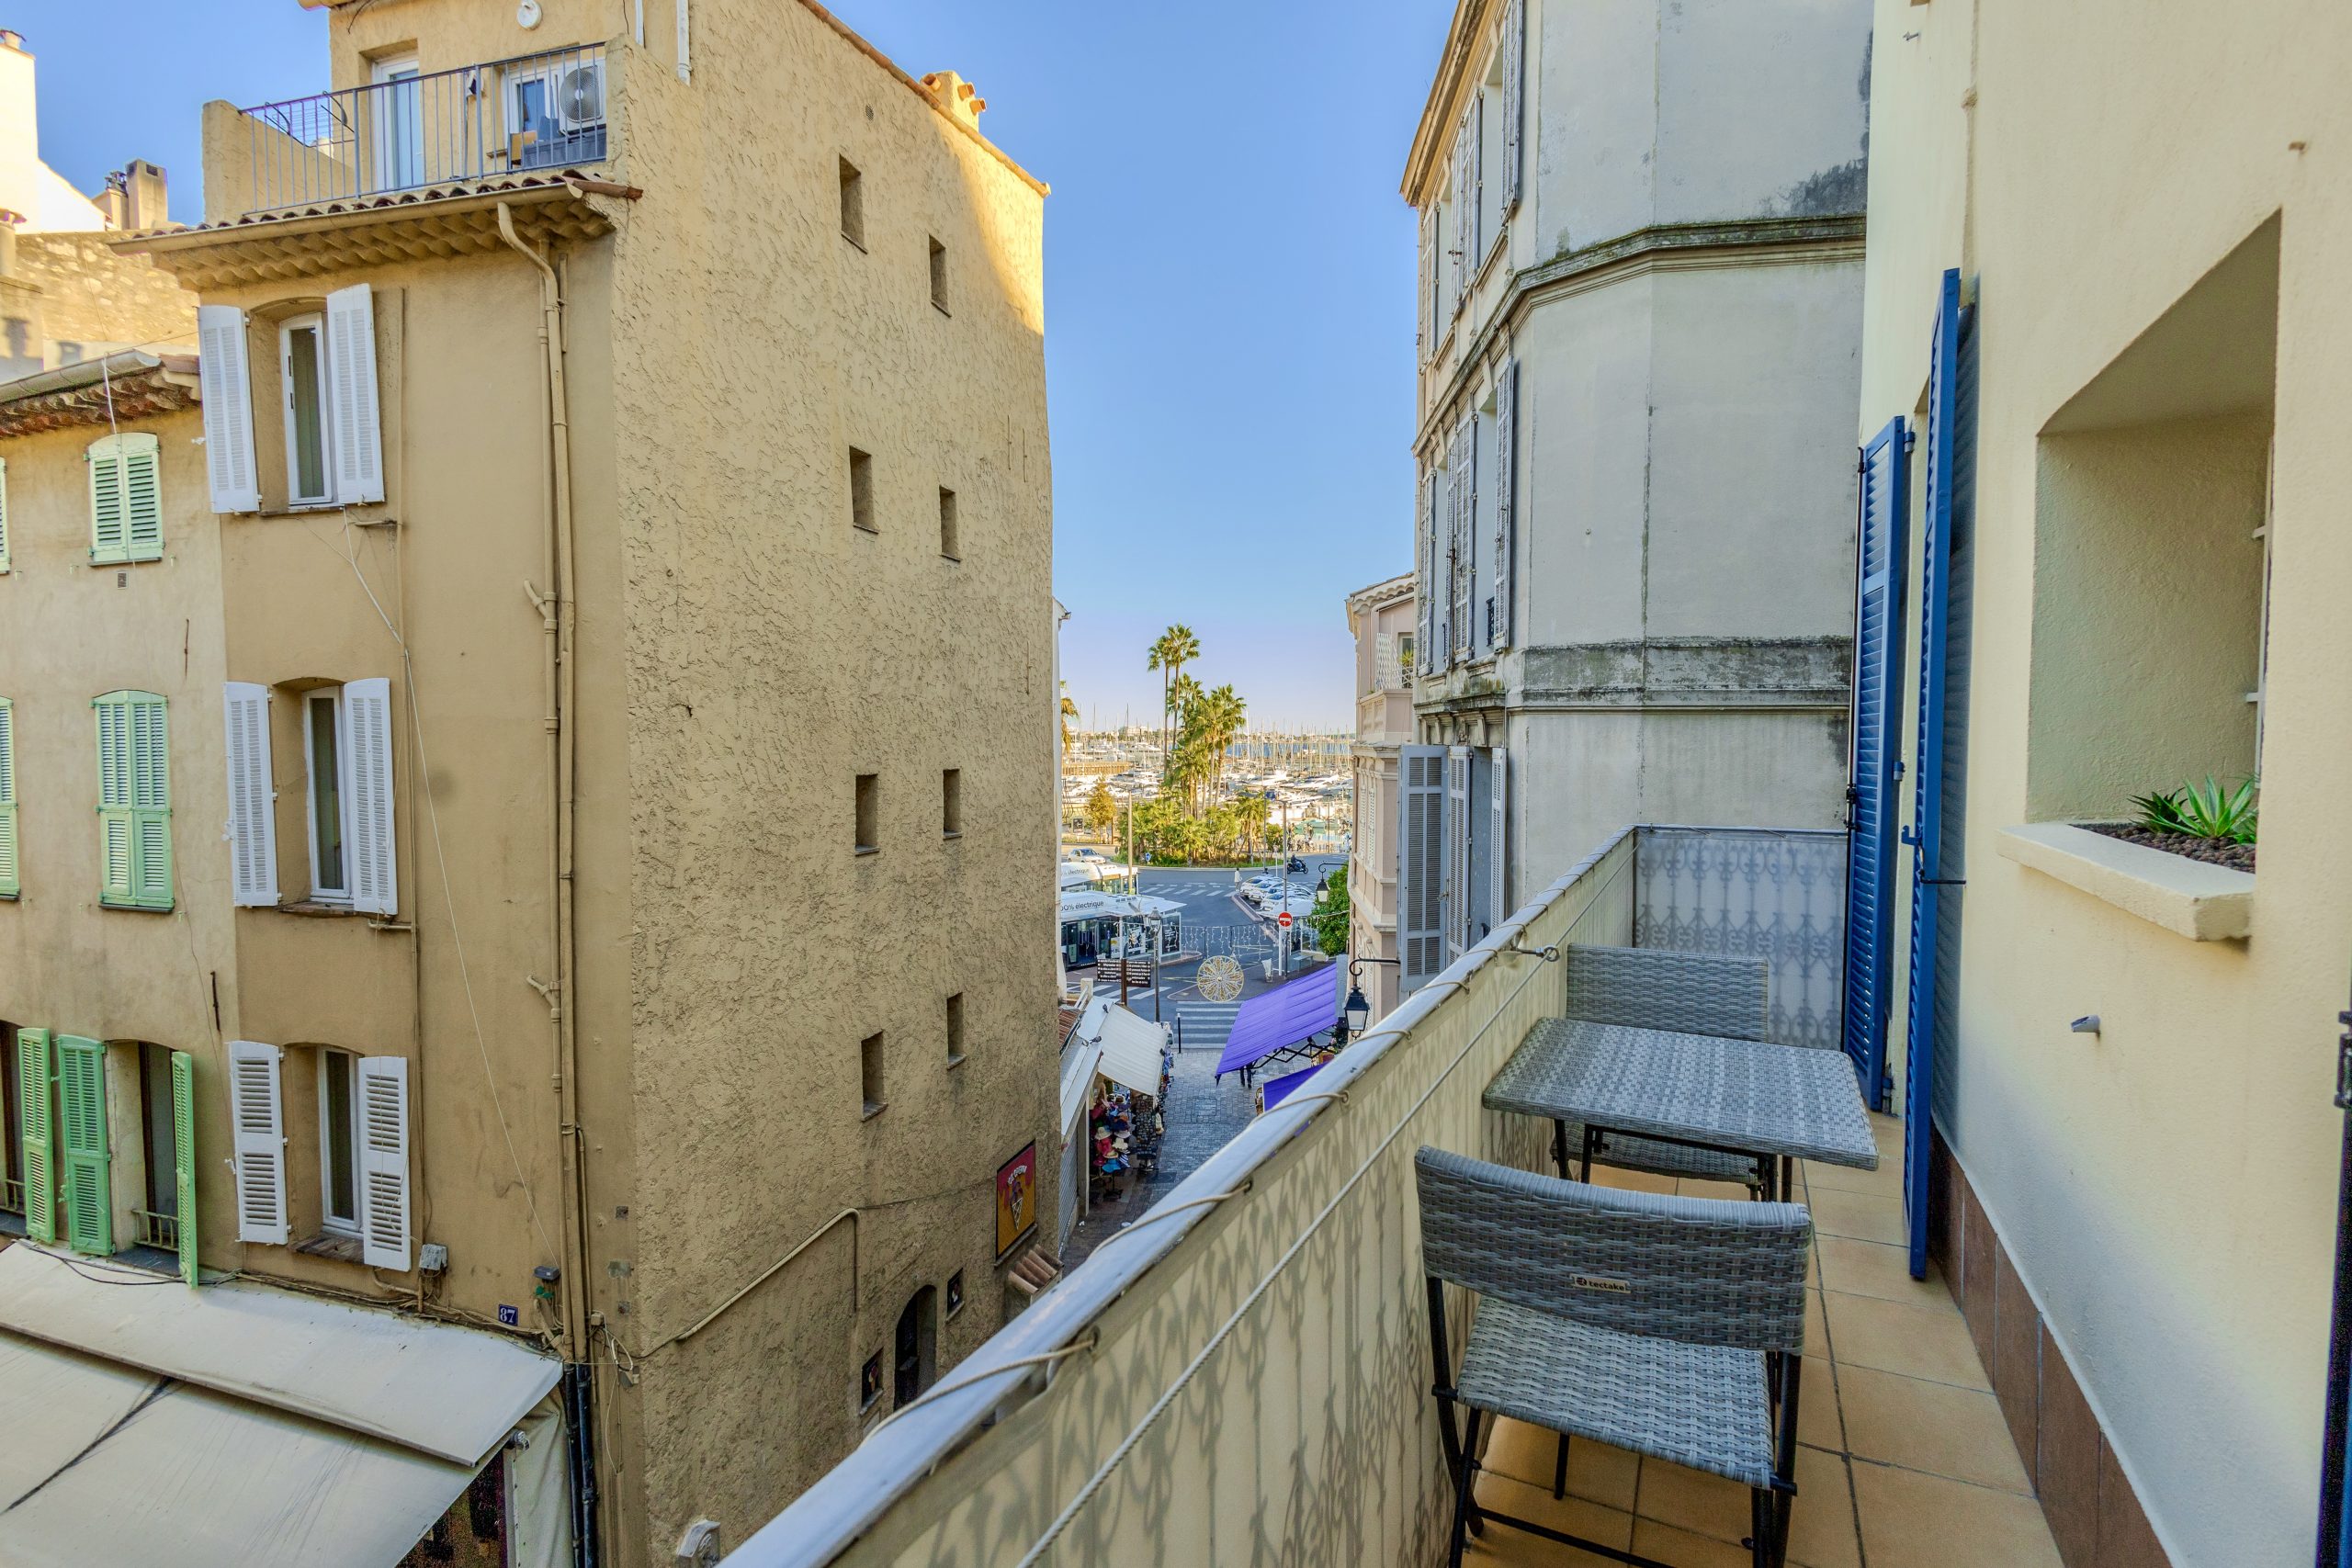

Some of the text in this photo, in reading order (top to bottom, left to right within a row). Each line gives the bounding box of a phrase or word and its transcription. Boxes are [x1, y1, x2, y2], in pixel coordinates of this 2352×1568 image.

[1075, 900, 1104, 910] électrique
[1589, 1280, 1624, 1291] tectake
[500, 1307, 516, 1323] 87
